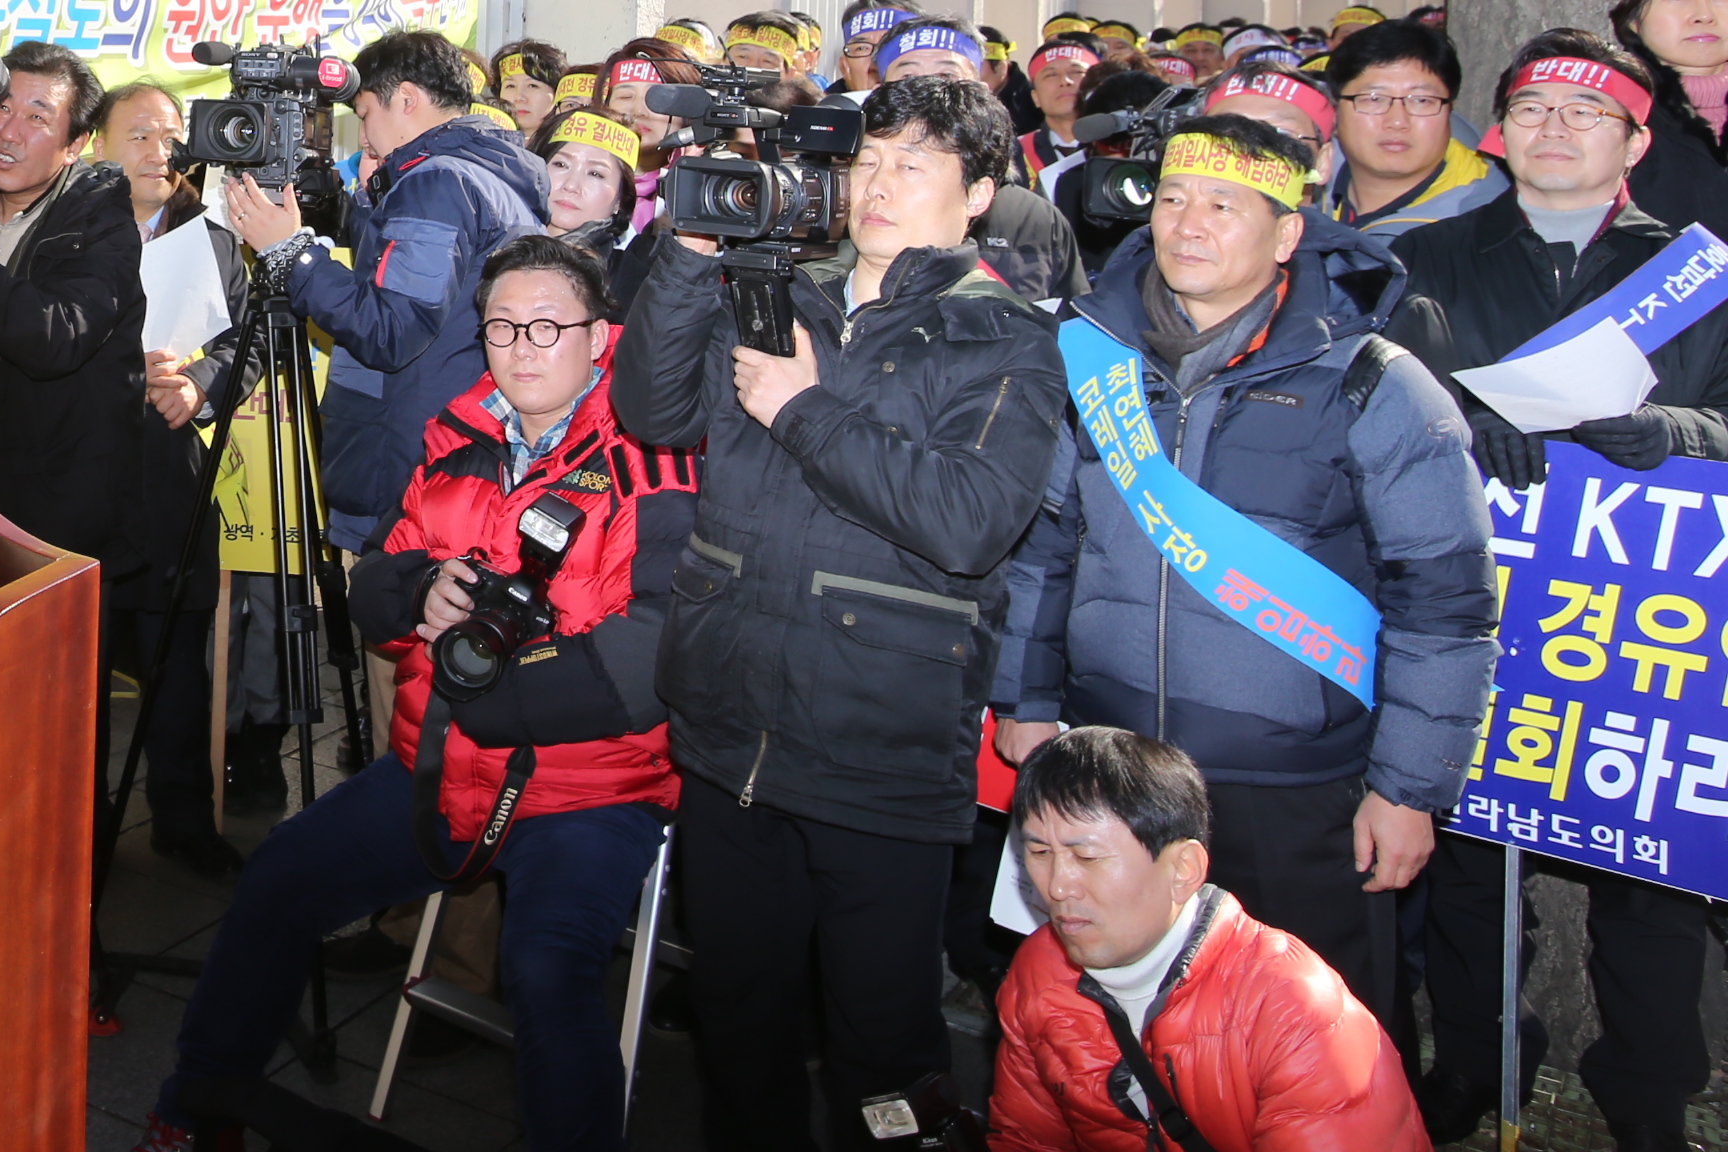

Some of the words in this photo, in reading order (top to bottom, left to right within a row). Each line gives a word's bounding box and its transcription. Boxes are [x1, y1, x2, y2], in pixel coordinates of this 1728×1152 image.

[1225, 74, 1299, 101] 반대!!
[1530, 59, 1610, 88] 반대!!
[563, 116, 588, 138] 경유
[592, 120, 636, 158] 결사반대
[1105, 357, 1160, 461] 최연혜
[224, 523, 255, 542] 광역
[1076, 376, 1138, 491] 코레일
[1137, 489, 1208, 572] 사장
[1214, 568, 1369, 686] 해임하라
[508, 587, 528, 601] Canon
[484, 787, 518, 846] Canon
